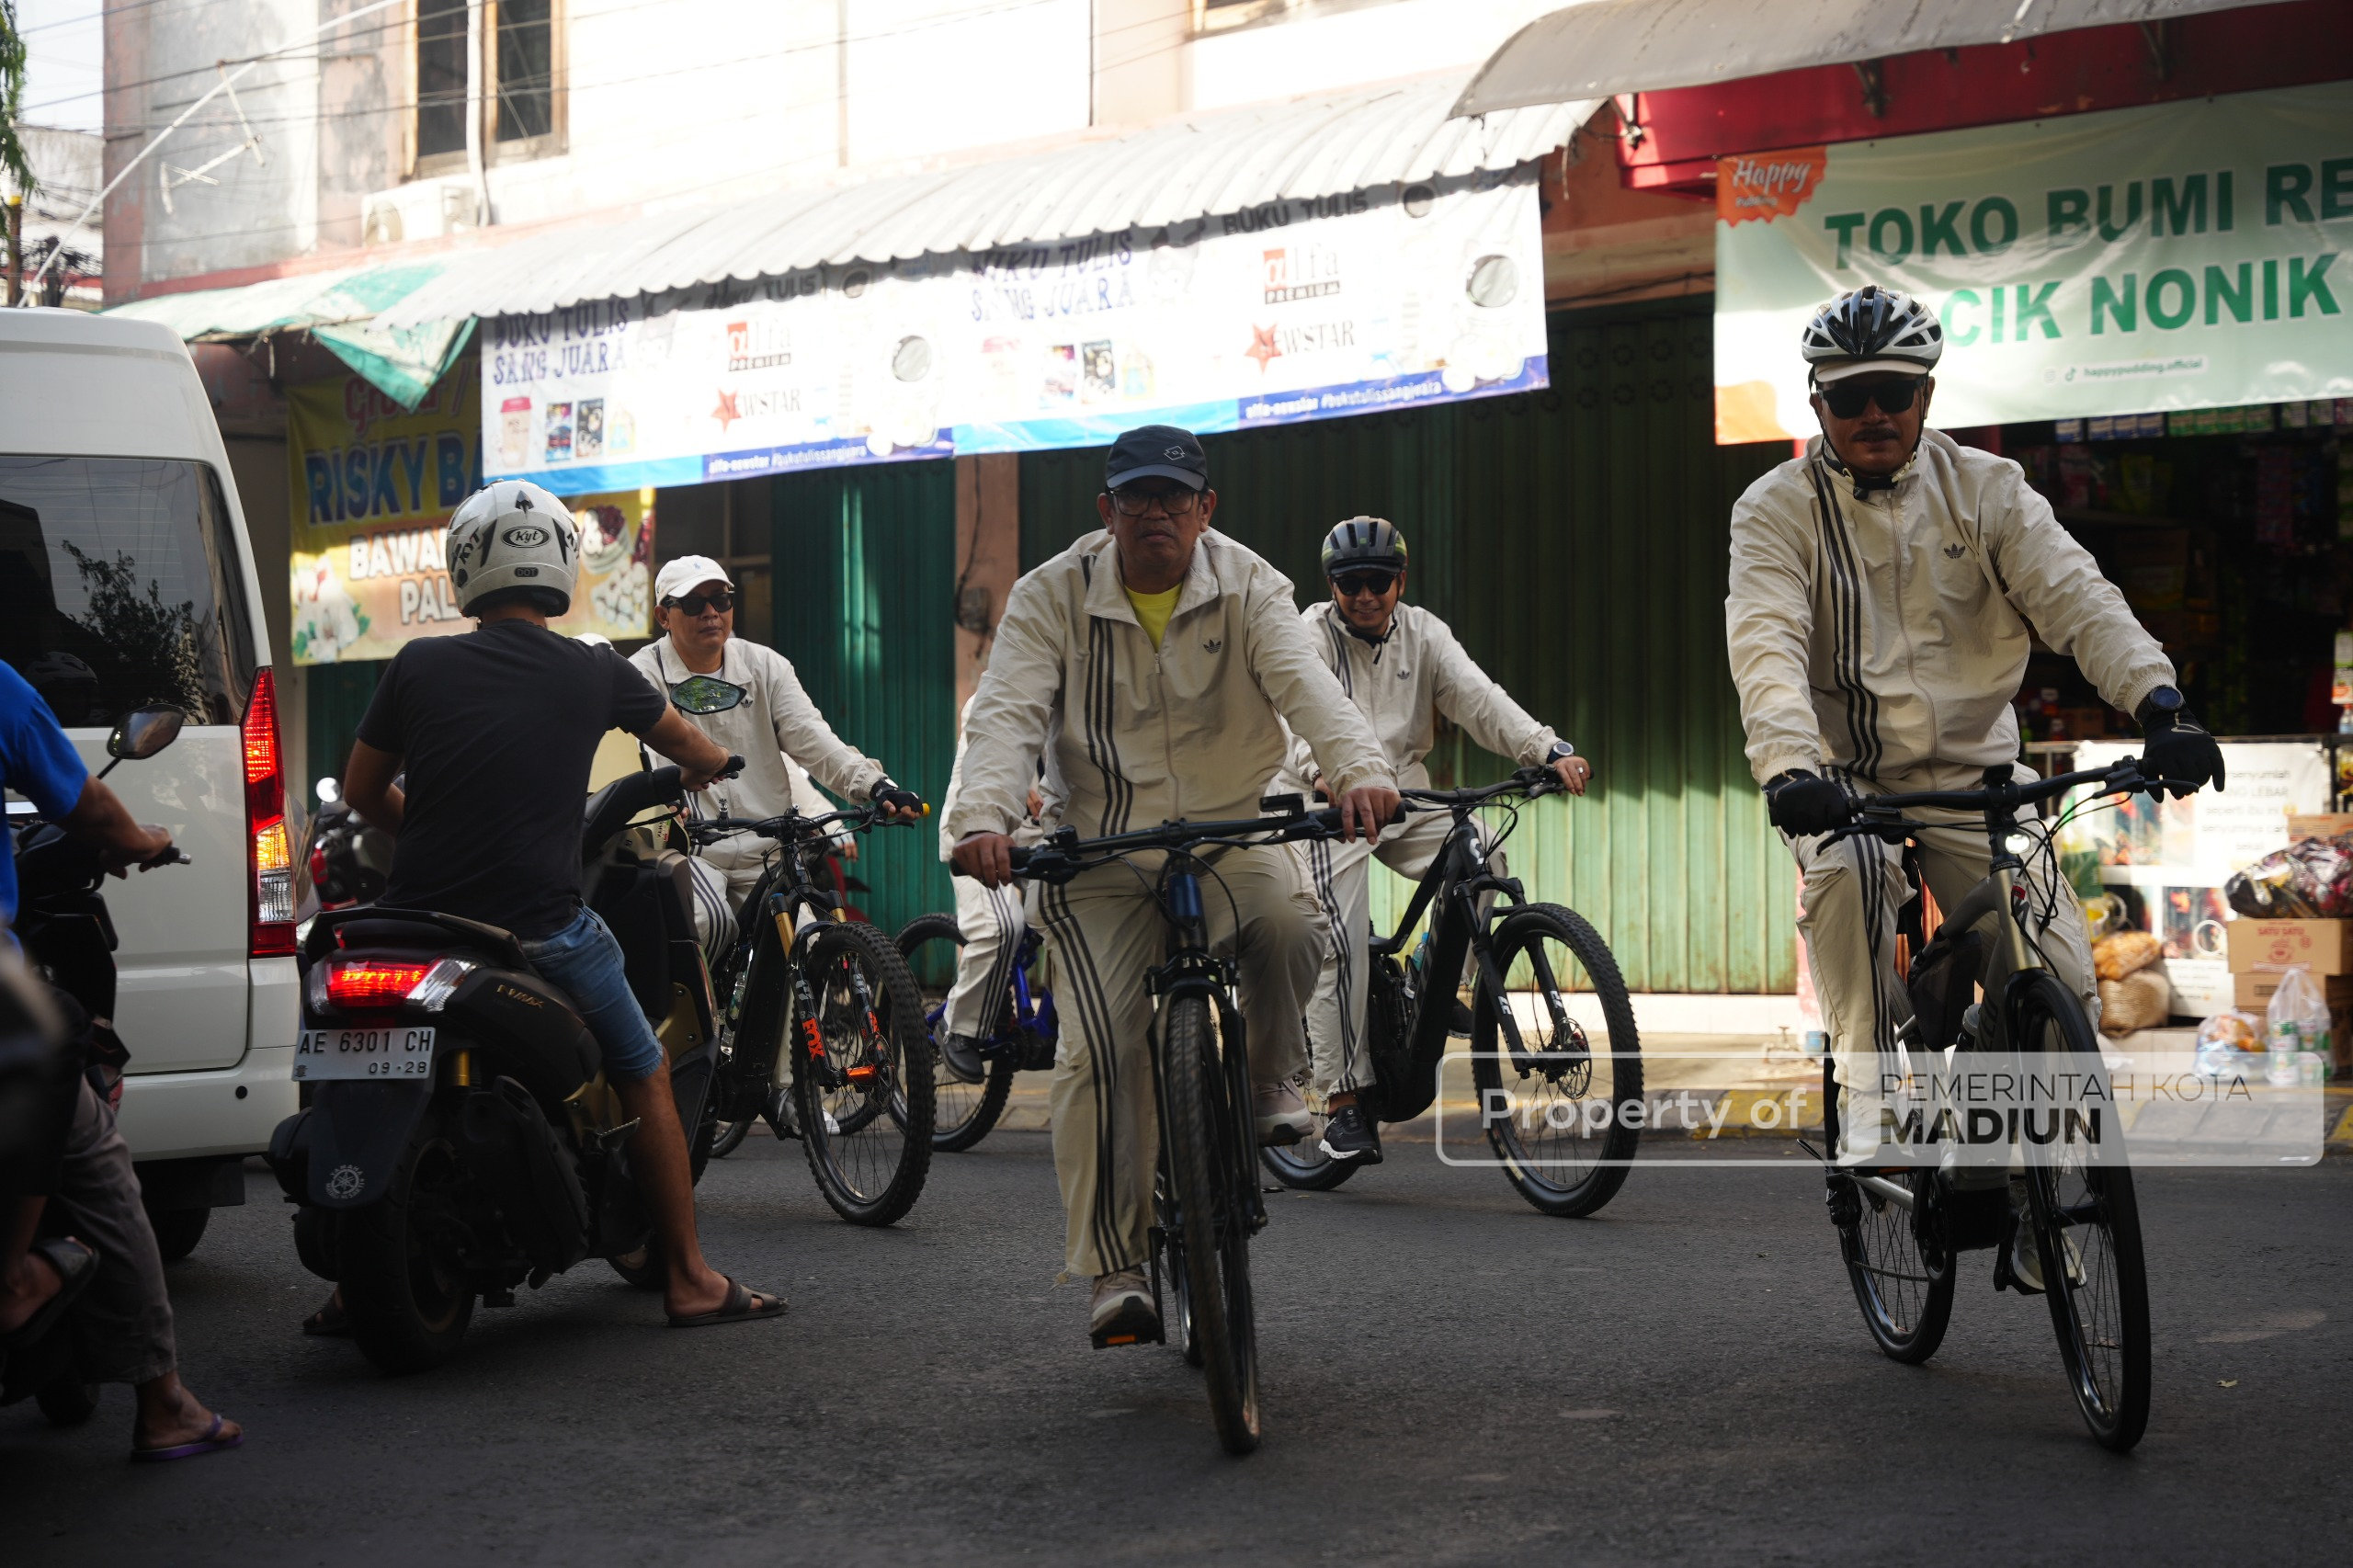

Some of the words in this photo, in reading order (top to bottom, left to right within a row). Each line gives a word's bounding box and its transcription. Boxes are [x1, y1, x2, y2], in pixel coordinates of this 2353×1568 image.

[1733, 160, 1811, 195] Happy
[1825, 196, 2018, 270] TOKO
[2047, 171, 2234, 250] BUMI
[1942, 280, 2063, 347] CIK
[2091, 253, 2342, 335] NONIK
[494, 350, 547, 384] SANG
[305, 437, 425, 525] RISKY
[516, 531, 540, 544] Kyt
[300, 1031, 327, 1055] AE
[339, 1030, 392, 1053] 6301
[405, 1029, 432, 1052] CH
[801, 1017, 825, 1060] FOX
